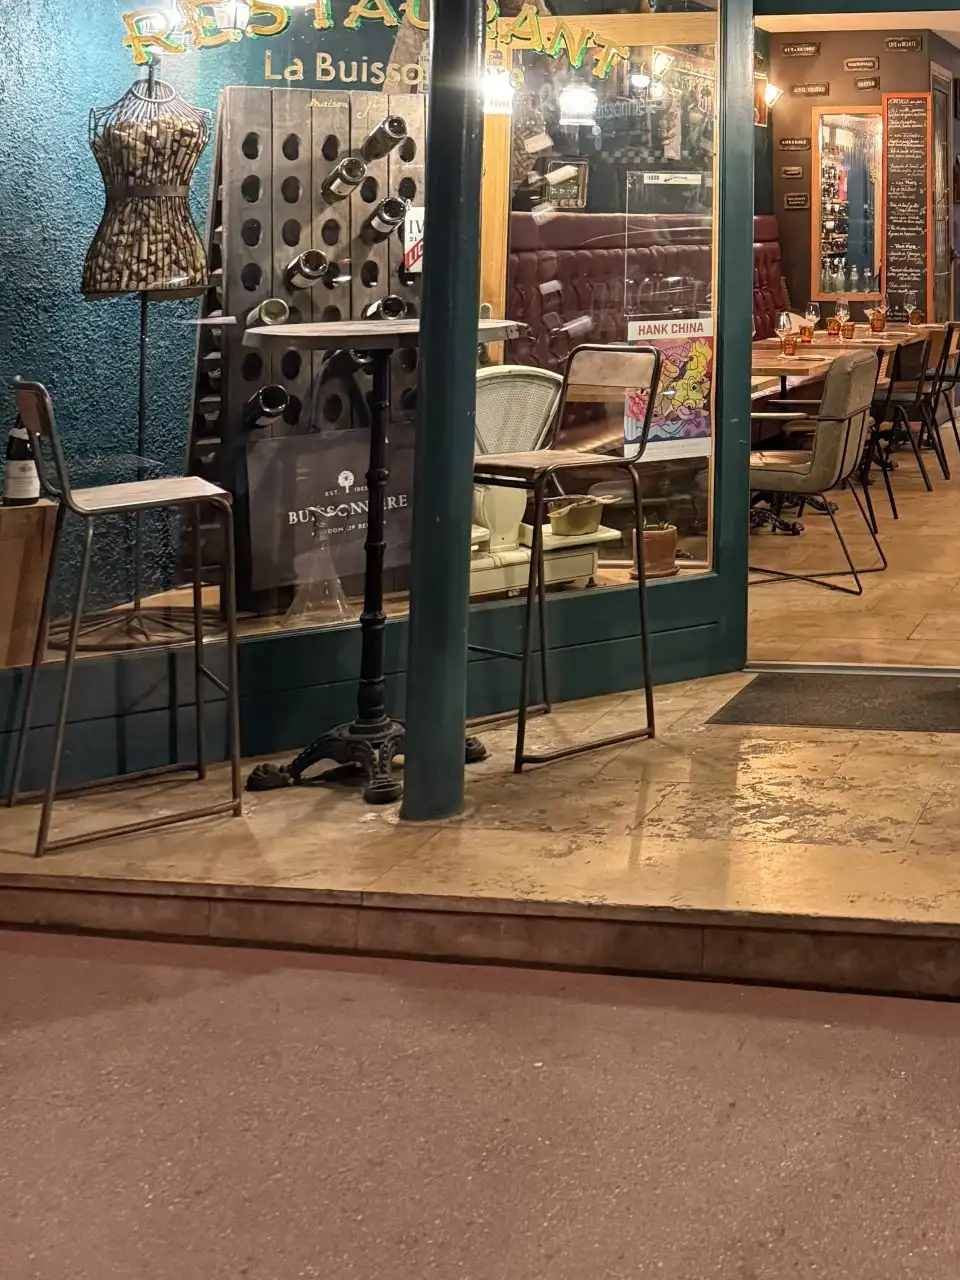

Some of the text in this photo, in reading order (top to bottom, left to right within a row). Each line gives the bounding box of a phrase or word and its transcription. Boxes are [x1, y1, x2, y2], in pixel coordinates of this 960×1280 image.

[264, 50, 303, 81] La
[638, 322, 704, 335] HANK CHINA
